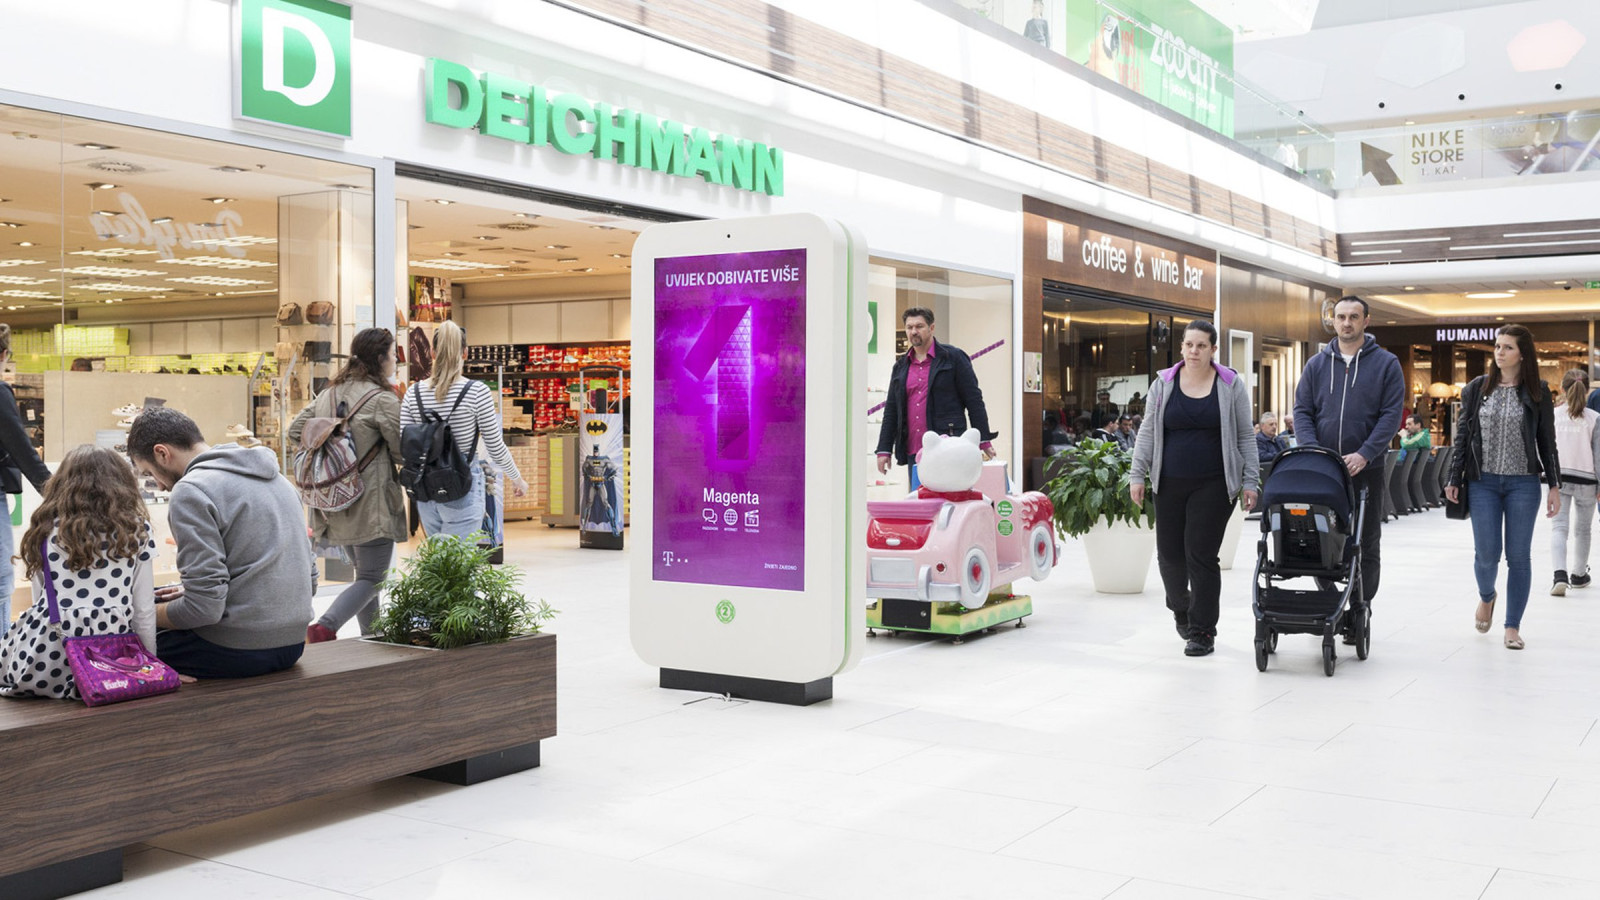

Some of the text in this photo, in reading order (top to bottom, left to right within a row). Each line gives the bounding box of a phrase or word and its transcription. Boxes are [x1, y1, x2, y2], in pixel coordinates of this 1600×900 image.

[262, 6, 336, 107] D
[425, 57, 784, 197] DEICHMANN
[1411, 129, 1464, 148] NIKE
[1411, 148, 1464, 165] STORE
[1434, 166, 1456, 175] KAT
[1082, 236, 1203, 290] coffee & wine bar
[665, 264, 799, 288] UVIJEK DOBIVATE VIŠE
[703, 487, 759, 506] Magenta
[722, 606, 729, 616] 2
